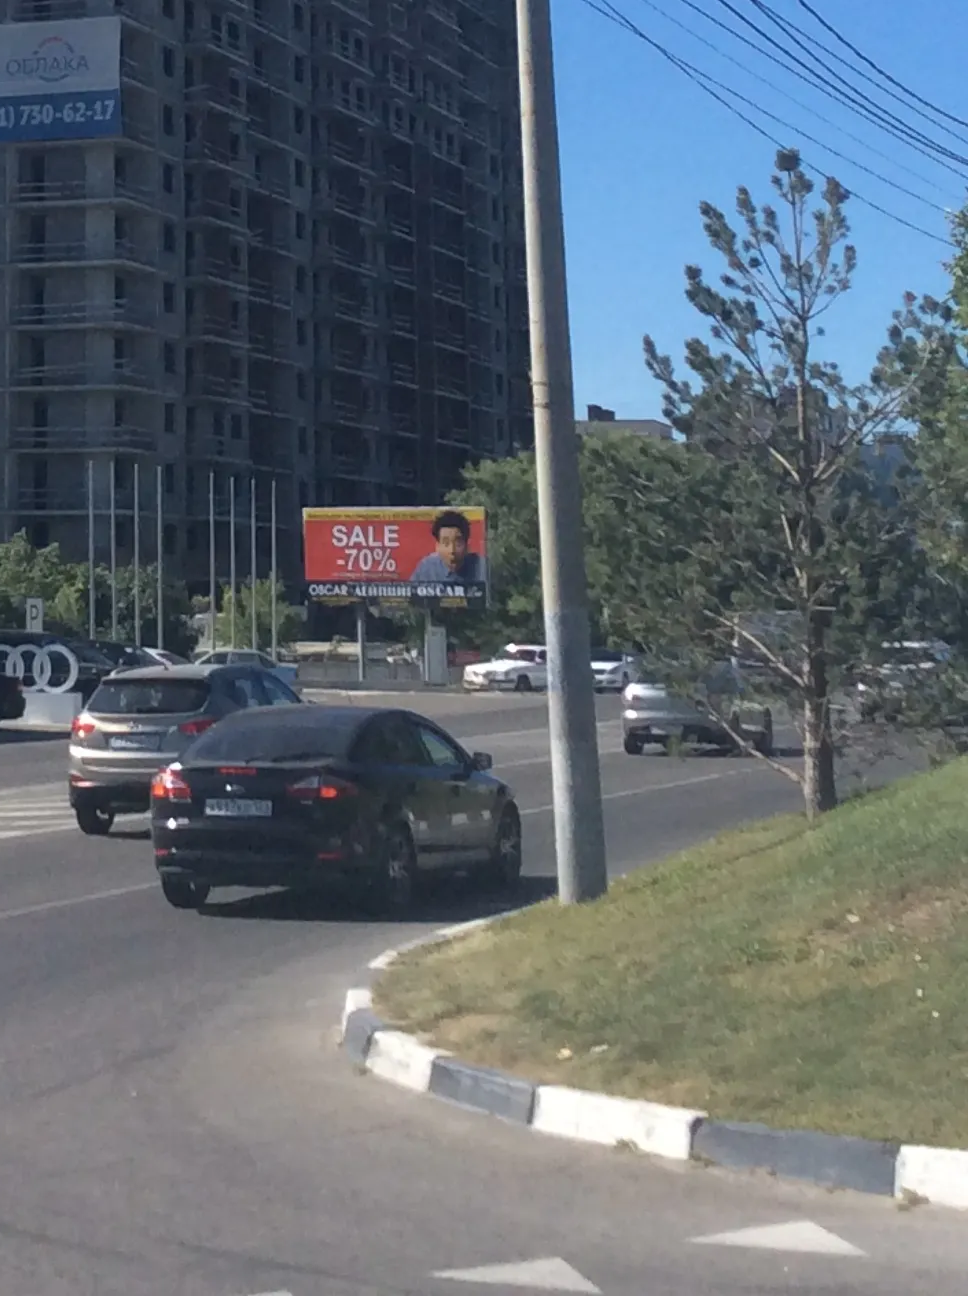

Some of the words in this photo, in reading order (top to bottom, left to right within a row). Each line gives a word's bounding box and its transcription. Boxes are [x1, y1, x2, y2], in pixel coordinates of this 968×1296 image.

[6, 55, 90, 77] ОБЛАКА
[19, 100, 115, 125] 730-62-17
[332, 525, 400, 547] SALE
[336, 549, 396, 572] -70%
[308, 584, 348, 596] OSCAR
[417, 584, 464, 597] OSCAR
